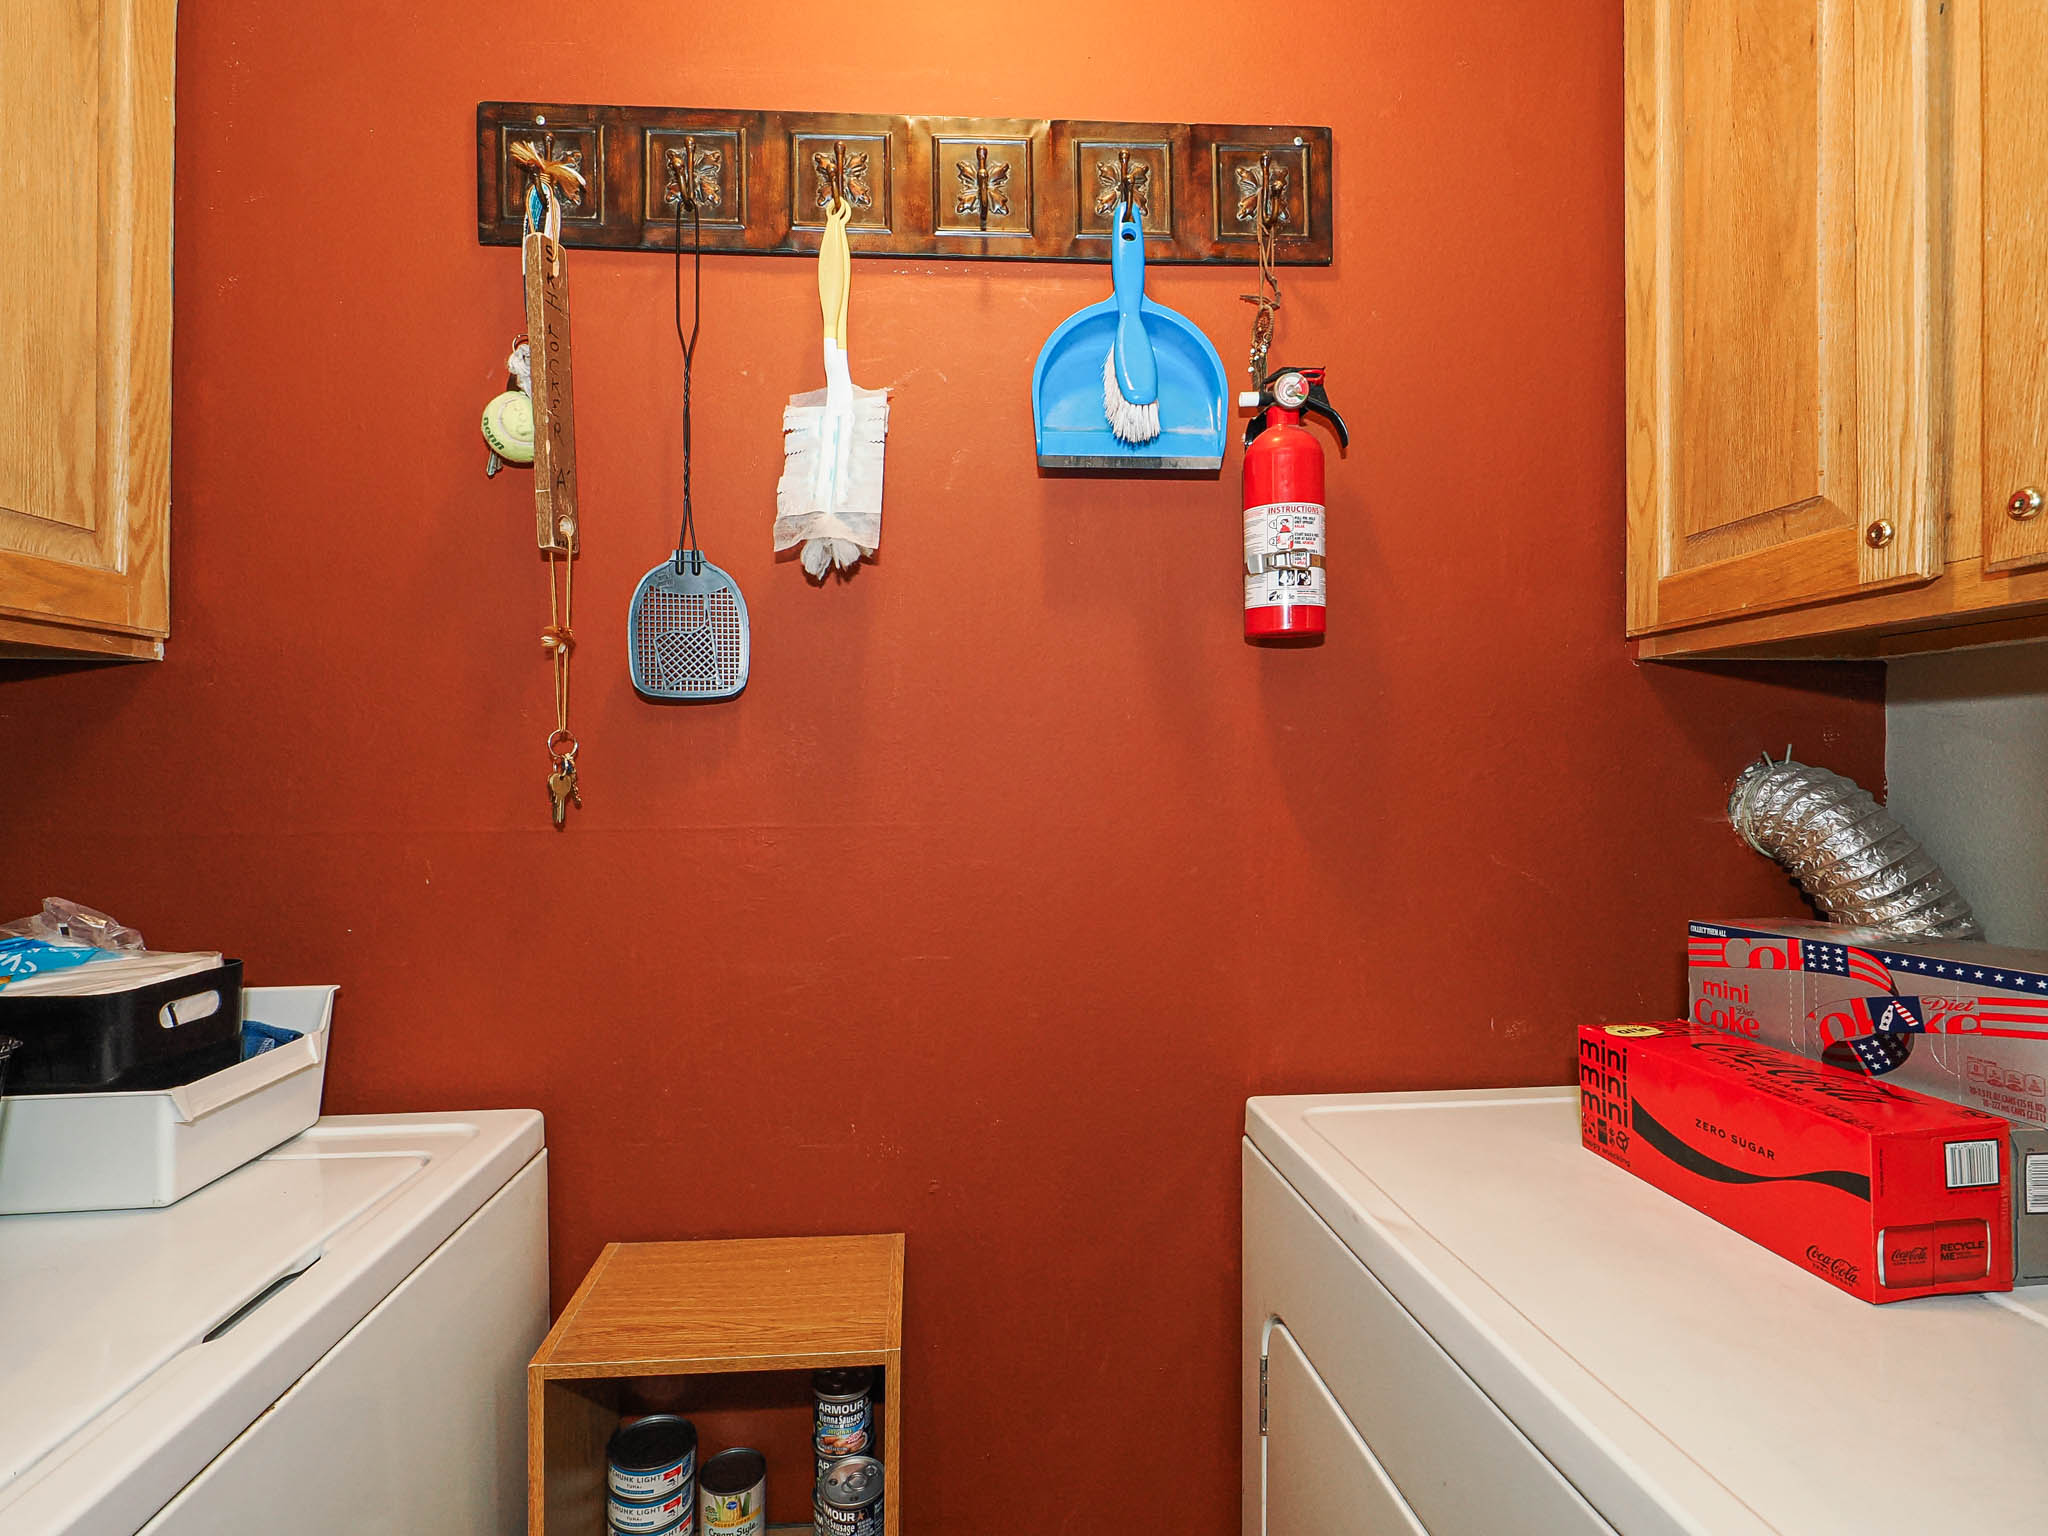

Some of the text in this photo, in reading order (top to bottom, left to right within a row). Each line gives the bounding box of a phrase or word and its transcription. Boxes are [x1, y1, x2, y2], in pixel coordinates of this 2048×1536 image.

[1268, 505, 1319, 515] INSTRUCTIONS
[1702, 978, 1749, 1004] mini
[1921, 996, 1976, 1012] Diet
[1694, 998, 1761, 1039] Coke
[1580, 1037, 1628, 1074] mini
[1581, 1063, 1628, 1100] mini
[1582, 1089, 1629, 1128] mini
[1695, 1118, 1776, 1161] ZERO SUGAR
[1940, 1240, 1985, 1252] RECYCLE
[1941, 1252, 1956, 1261] ME
[818, 1399, 864, 1415] ARMOUR
[819, 1411, 864, 1425] Vienna Sausage
[612, 1469, 662, 1484] CHUNK LIGHT
[612, 1501, 662, 1516] CHUNK LIGHT
[736, 1521, 757, 1536] Style
